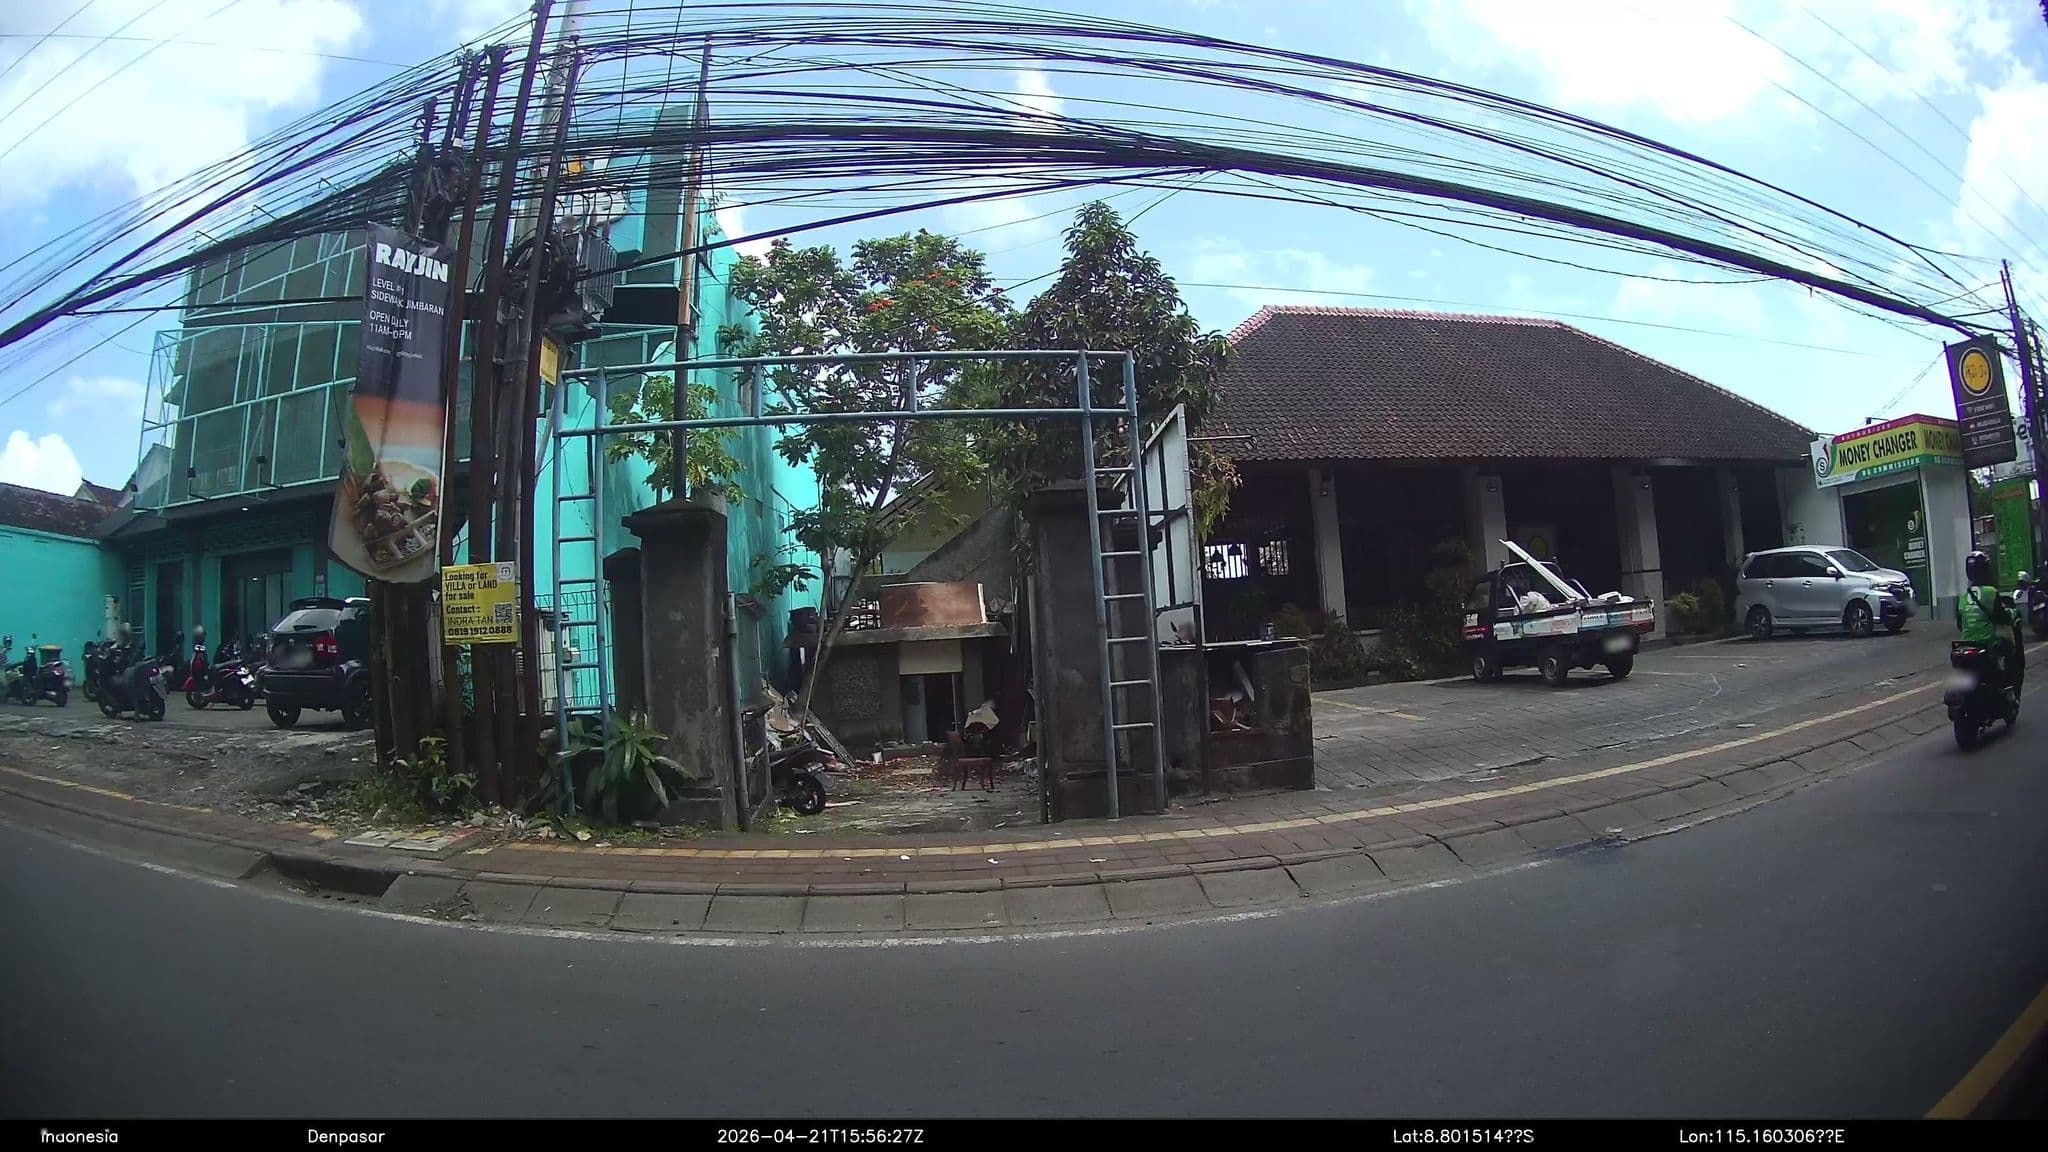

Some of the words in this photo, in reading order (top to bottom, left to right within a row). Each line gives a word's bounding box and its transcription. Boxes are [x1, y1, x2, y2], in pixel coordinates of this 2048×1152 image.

[376, 243, 448, 282] RAYJIN
[372, 277, 395, 292] LEVEL
[405, 299, 445, 316] JIMBARAN
[369, 310, 390, 324] OPEN
[1839, 441, 1871, 467] MONEY
[1873, 431, 1917, 458] CHANGER
[445, 572, 475, 582] Looking
[477, 571, 488, 580] for
[445, 581, 466, 591] VILLA
[478, 580, 497, 590] LAND
[445, 592, 457, 601] for
[459, 591, 475, 600] sale
[447, 605, 475, 614] Contact
[447, 616, 474, 626] INDRA
[476, 615, 494, 624] TAN
